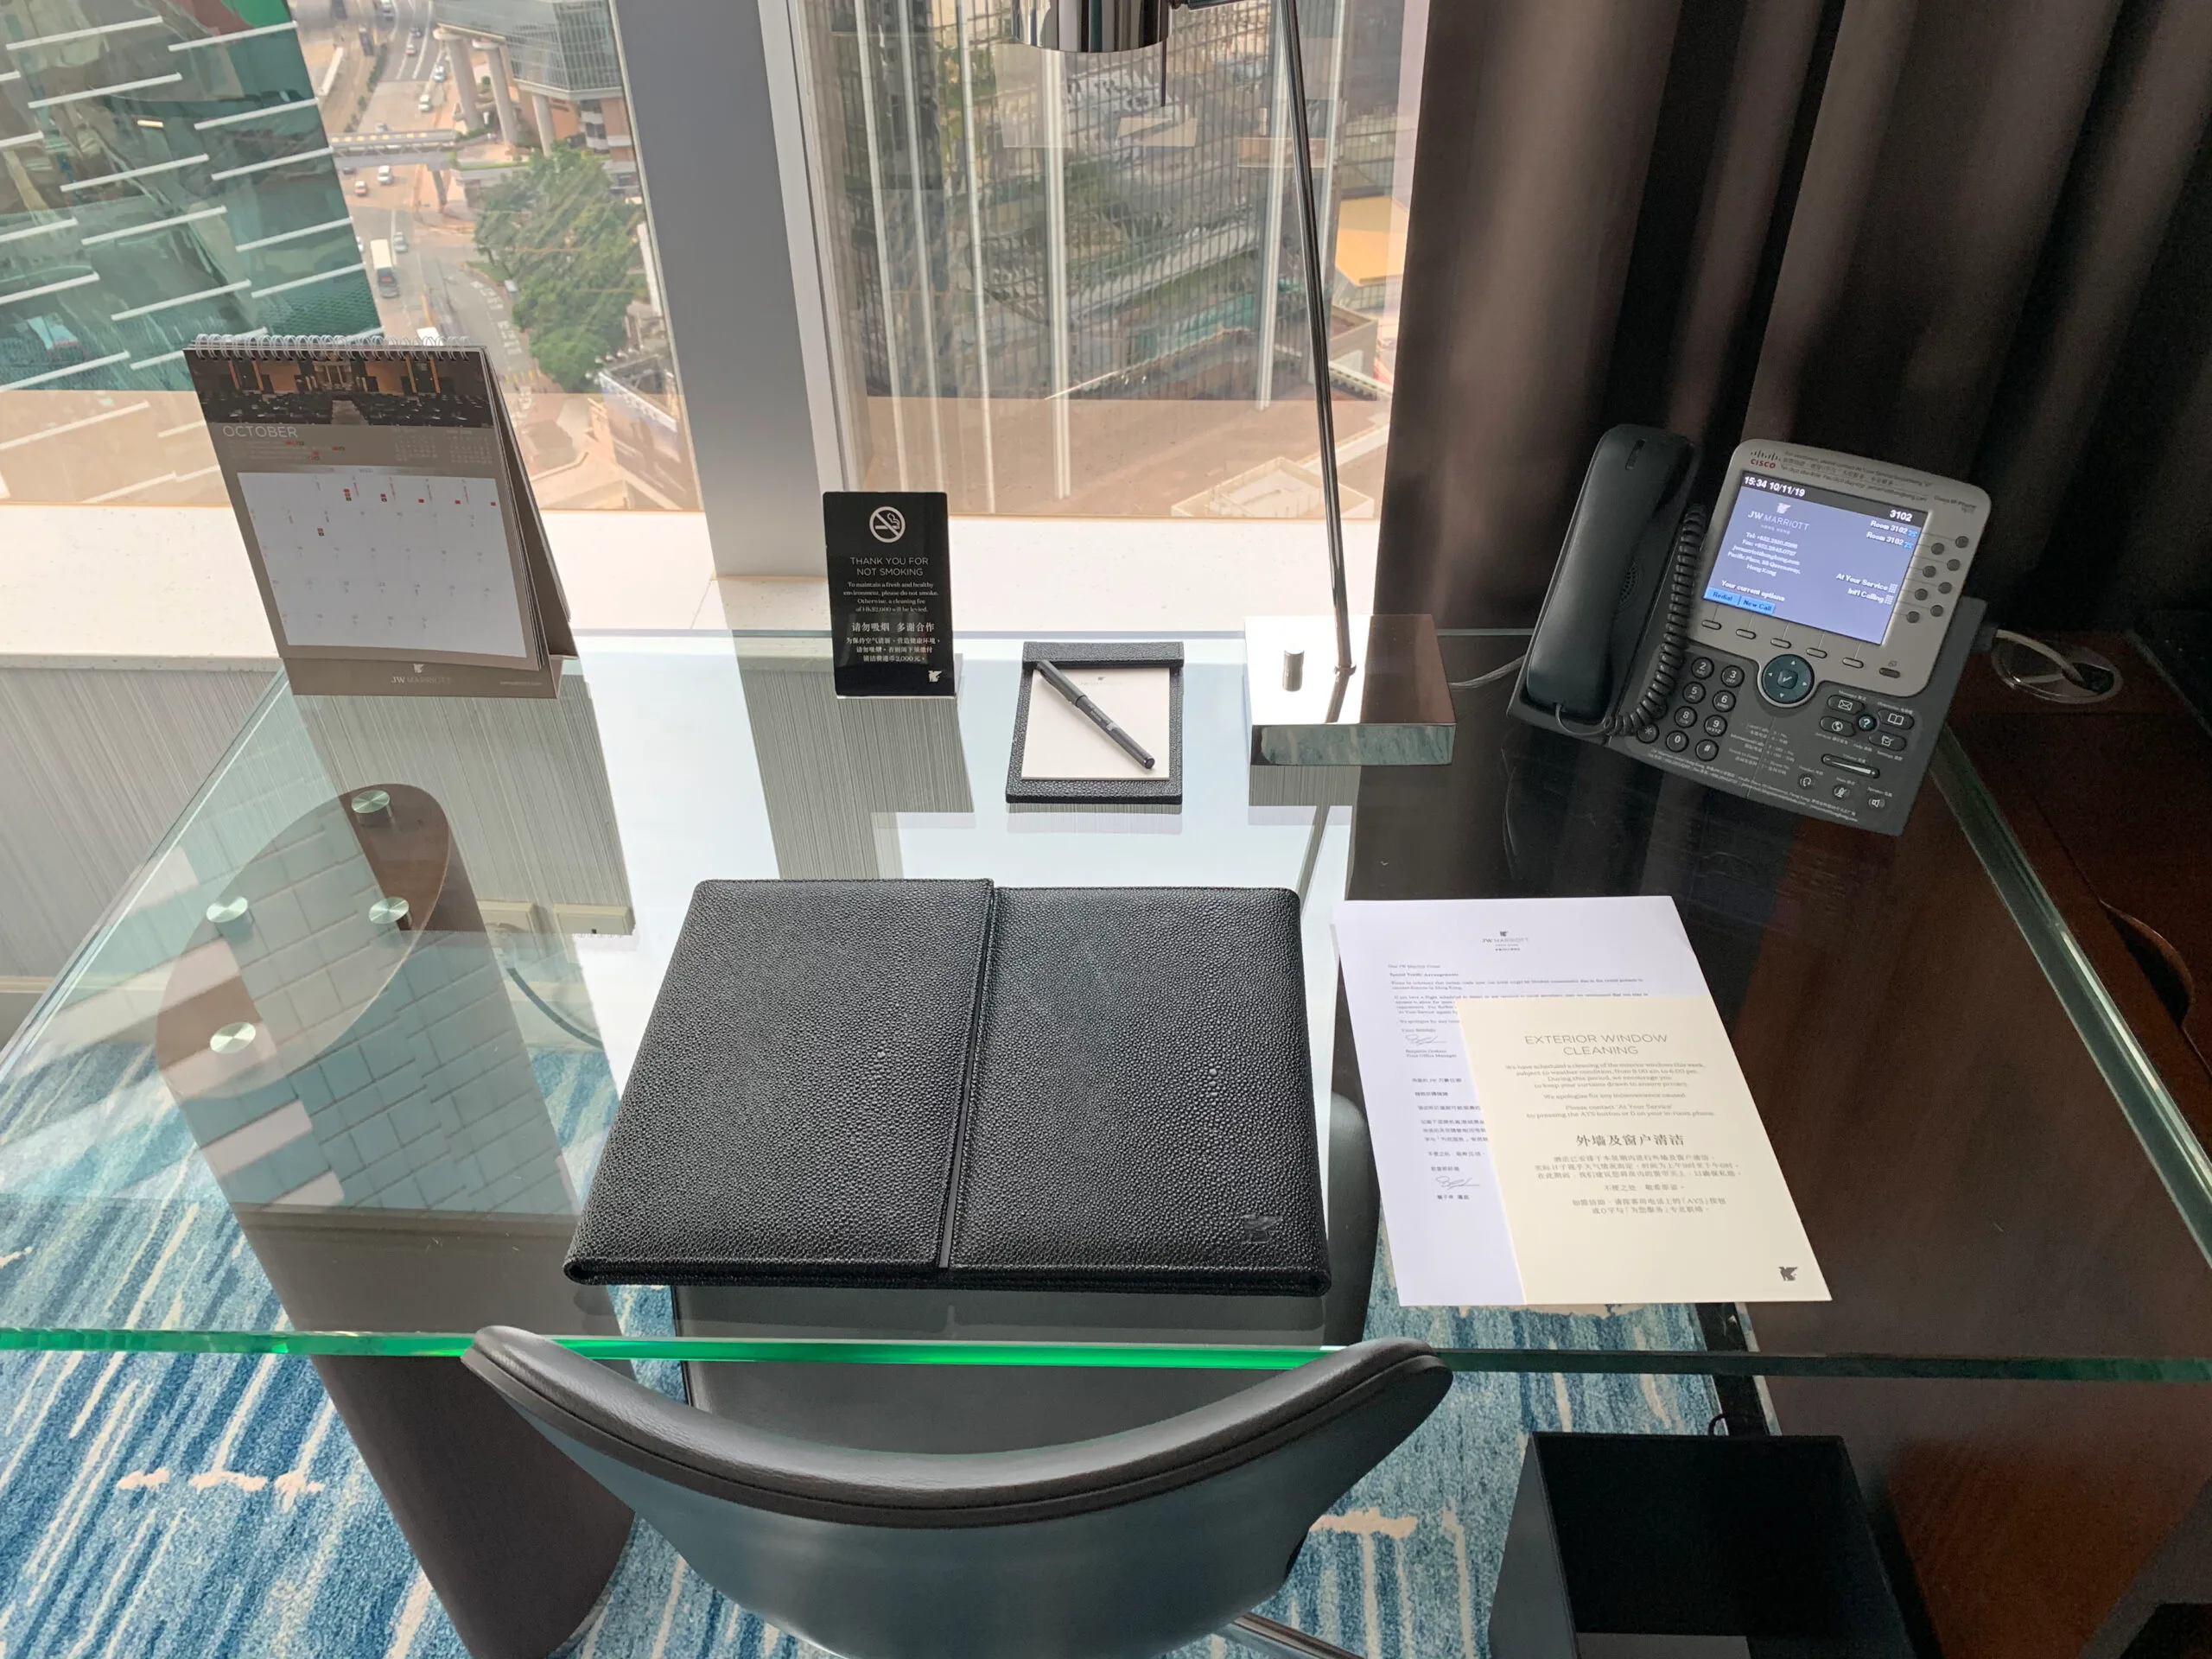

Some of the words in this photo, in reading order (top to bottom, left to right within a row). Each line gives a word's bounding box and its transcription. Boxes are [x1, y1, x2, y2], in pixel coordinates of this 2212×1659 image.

[223, 425, 299, 438] OCTOBER
[1750, 458, 1777, 469] CISCO
[1745, 476, 1768, 489] 15:34
[1769, 481, 1806, 497] 10/11/19
[1889, 509, 1913, 522] 3102
[1747, 511, 1764, 520] JW
[1764, 515, 1810, 531] MARRIOTT
[1870, 520, 1890, 531] Room
[1890, 524, 1909, 535] 3102
[1866, 531, 1885, 542] Room
[1885, 536, 1904, 546] 3102
[850, 556, 883, 566] THANK
[886, 556, 906, 566] YOU
[909, 556, 929, 566] FOR
[856, 568, 877, 576] NOT
[880, 568, 924, 576] SMOKING
[912, 582, 934, 590] healthy
[1846, 575, 1861, 584] Your
[1861, 579, 1889, 591] Service
[1713, 591, 1733, 601] Redial
[1721, 580, 1735, 589] Your
[1737, 585, 1760, 595] current
[1761, 590, 1785, 602] options
[893, 598, 917, 607] cleaning
[1860, 591, 1885, 604] Calling
[1758, 603, 1772, 612] Call
[852, 622, 890, 632] 请勿吸烟
[896, 622, 935, 632] 多谢合作
[1699, 662, 1707, 671] 2
[1729, 670, 1738, 679] 3
[1691, 686, 1698, 695] 5
[1720, 695, 1728, 703] 6
[1682, 710, 1690, 720] 8
[1713, 720, 1720, 728] 9
[1674, 735, 1681, 744] 0
[1524, 1034, 1597, 1045] EXTERIOR
[1600, 1033, 1668, 1043] WINDOW
[1563, 1046, 1639, 1055] CLEANING
[1576, 1134, 1684, 1147] 外墙及窗户清洁
